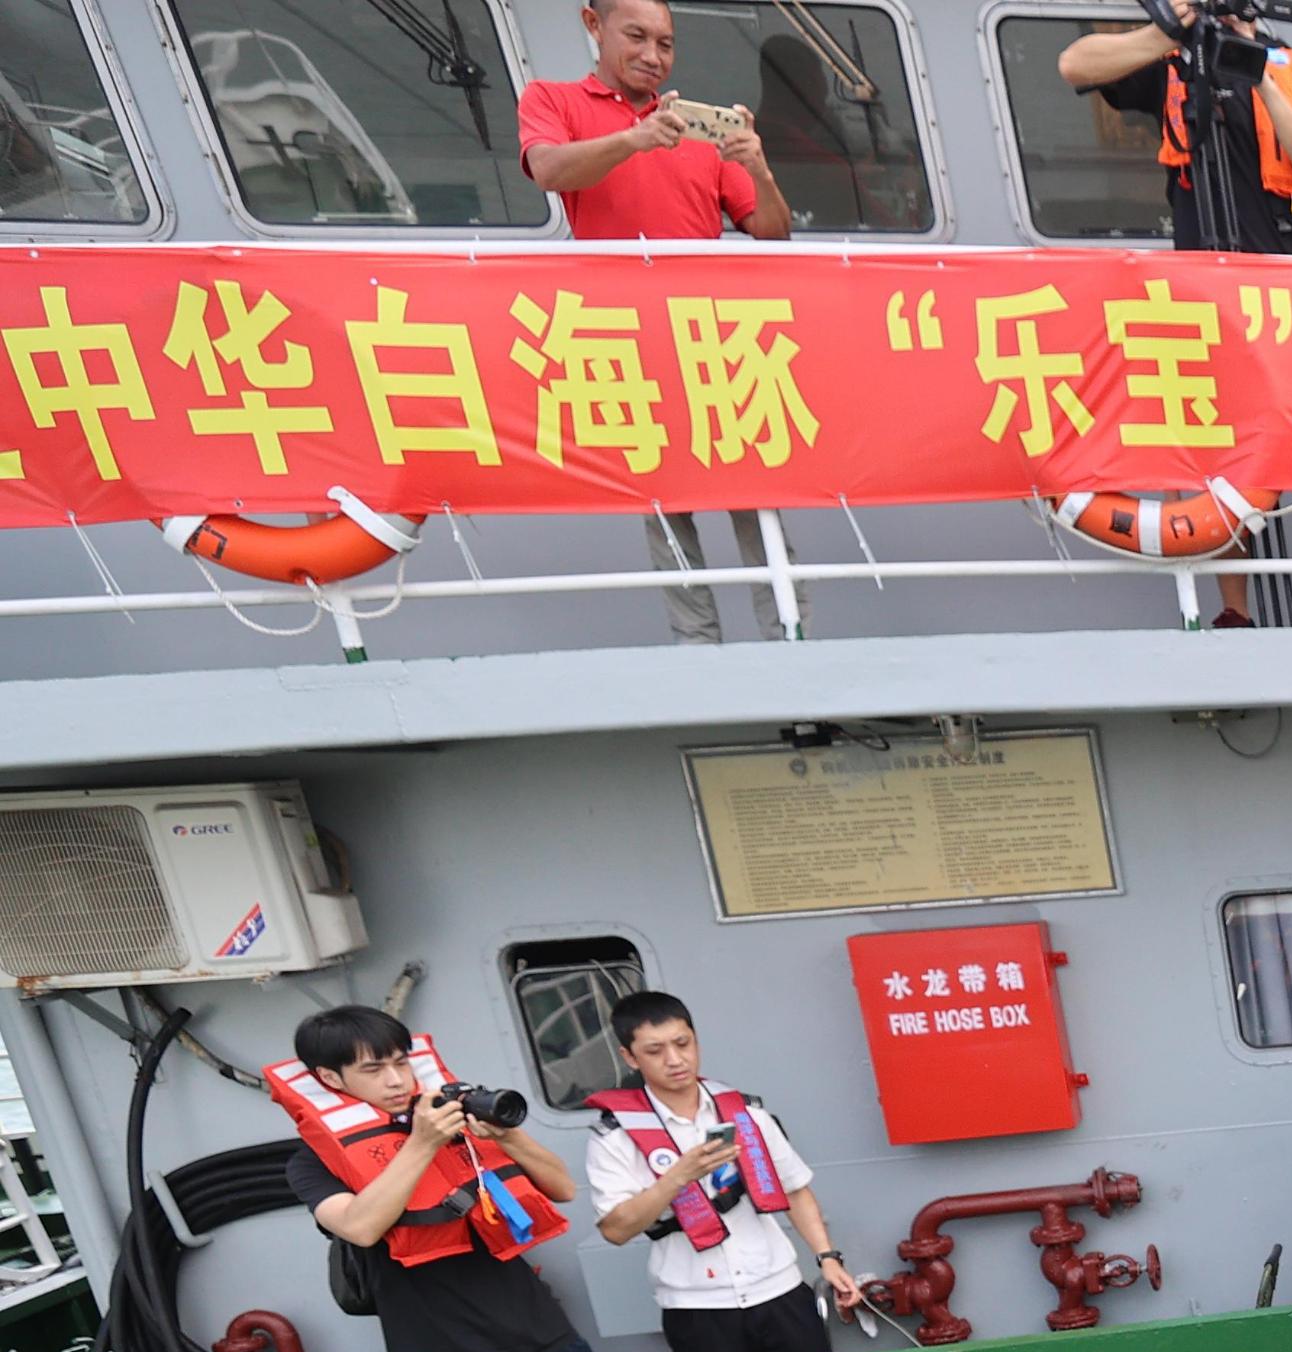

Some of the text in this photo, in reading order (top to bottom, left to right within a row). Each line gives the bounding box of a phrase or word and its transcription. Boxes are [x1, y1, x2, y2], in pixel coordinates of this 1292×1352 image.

[191, 823, 235, 836] GREE
[883, 961, 1025, 1000] 水龙带箱
[889, 1003, 1030, 1036] FIRE HOSE BOX
